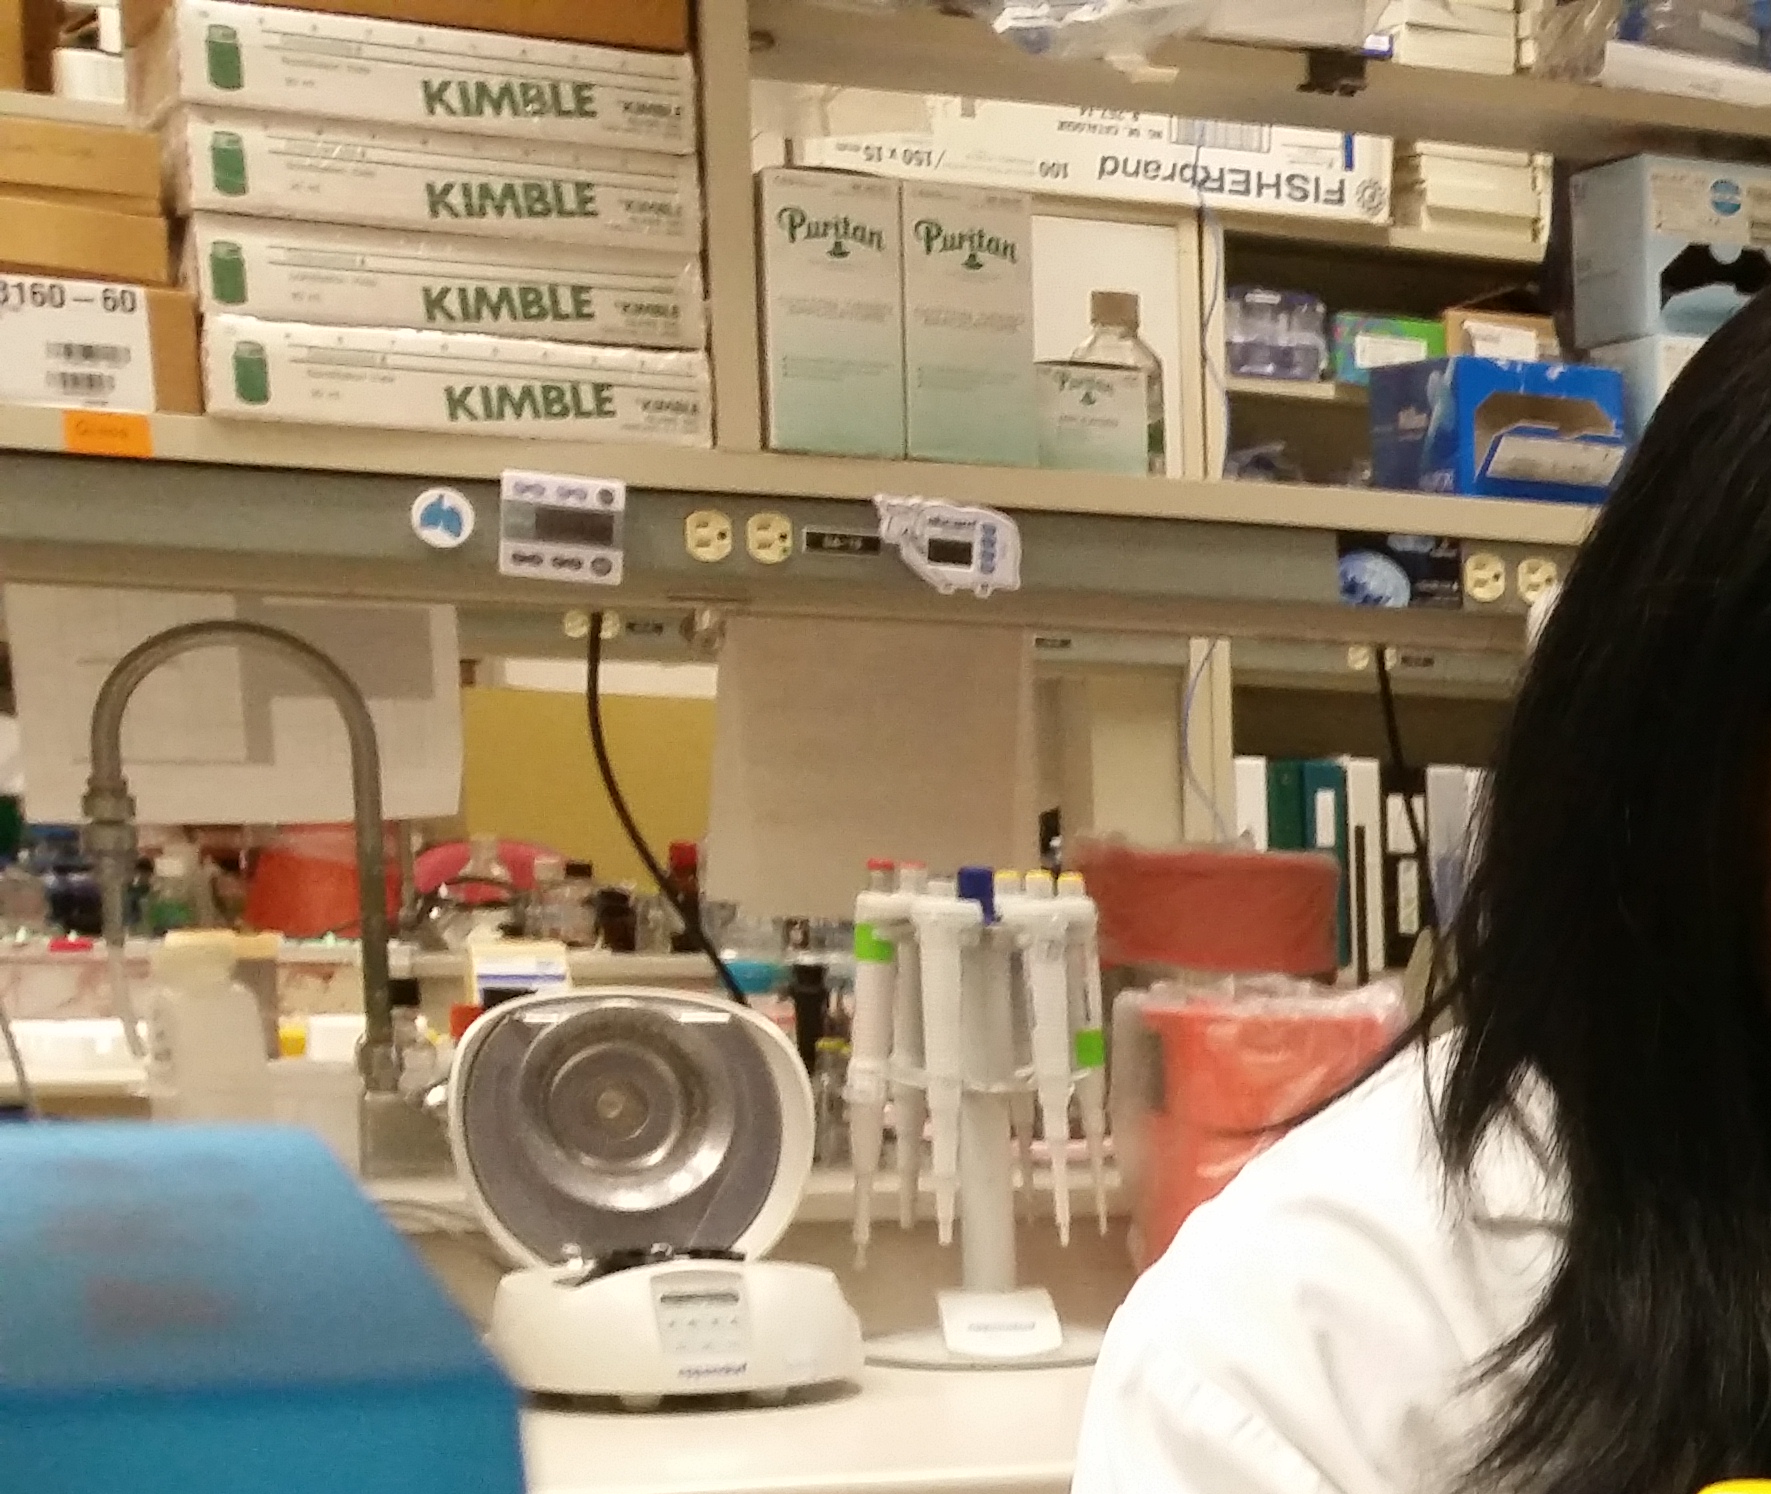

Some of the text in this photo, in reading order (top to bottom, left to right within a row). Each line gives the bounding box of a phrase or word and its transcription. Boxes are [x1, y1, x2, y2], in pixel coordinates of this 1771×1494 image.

[422, 79, 598, 118] KIMBLE
[425, 180, 598, 219] KIMBLE
[1096, 154, 1346, 207] FISHERbrand
[777, 206, 886, 252] Puritan
[914, 219, 1018, 264] Puritan
[422, 284, 595, 323] KIMBLE
[444, 381, 616, 422] KIMBLE
